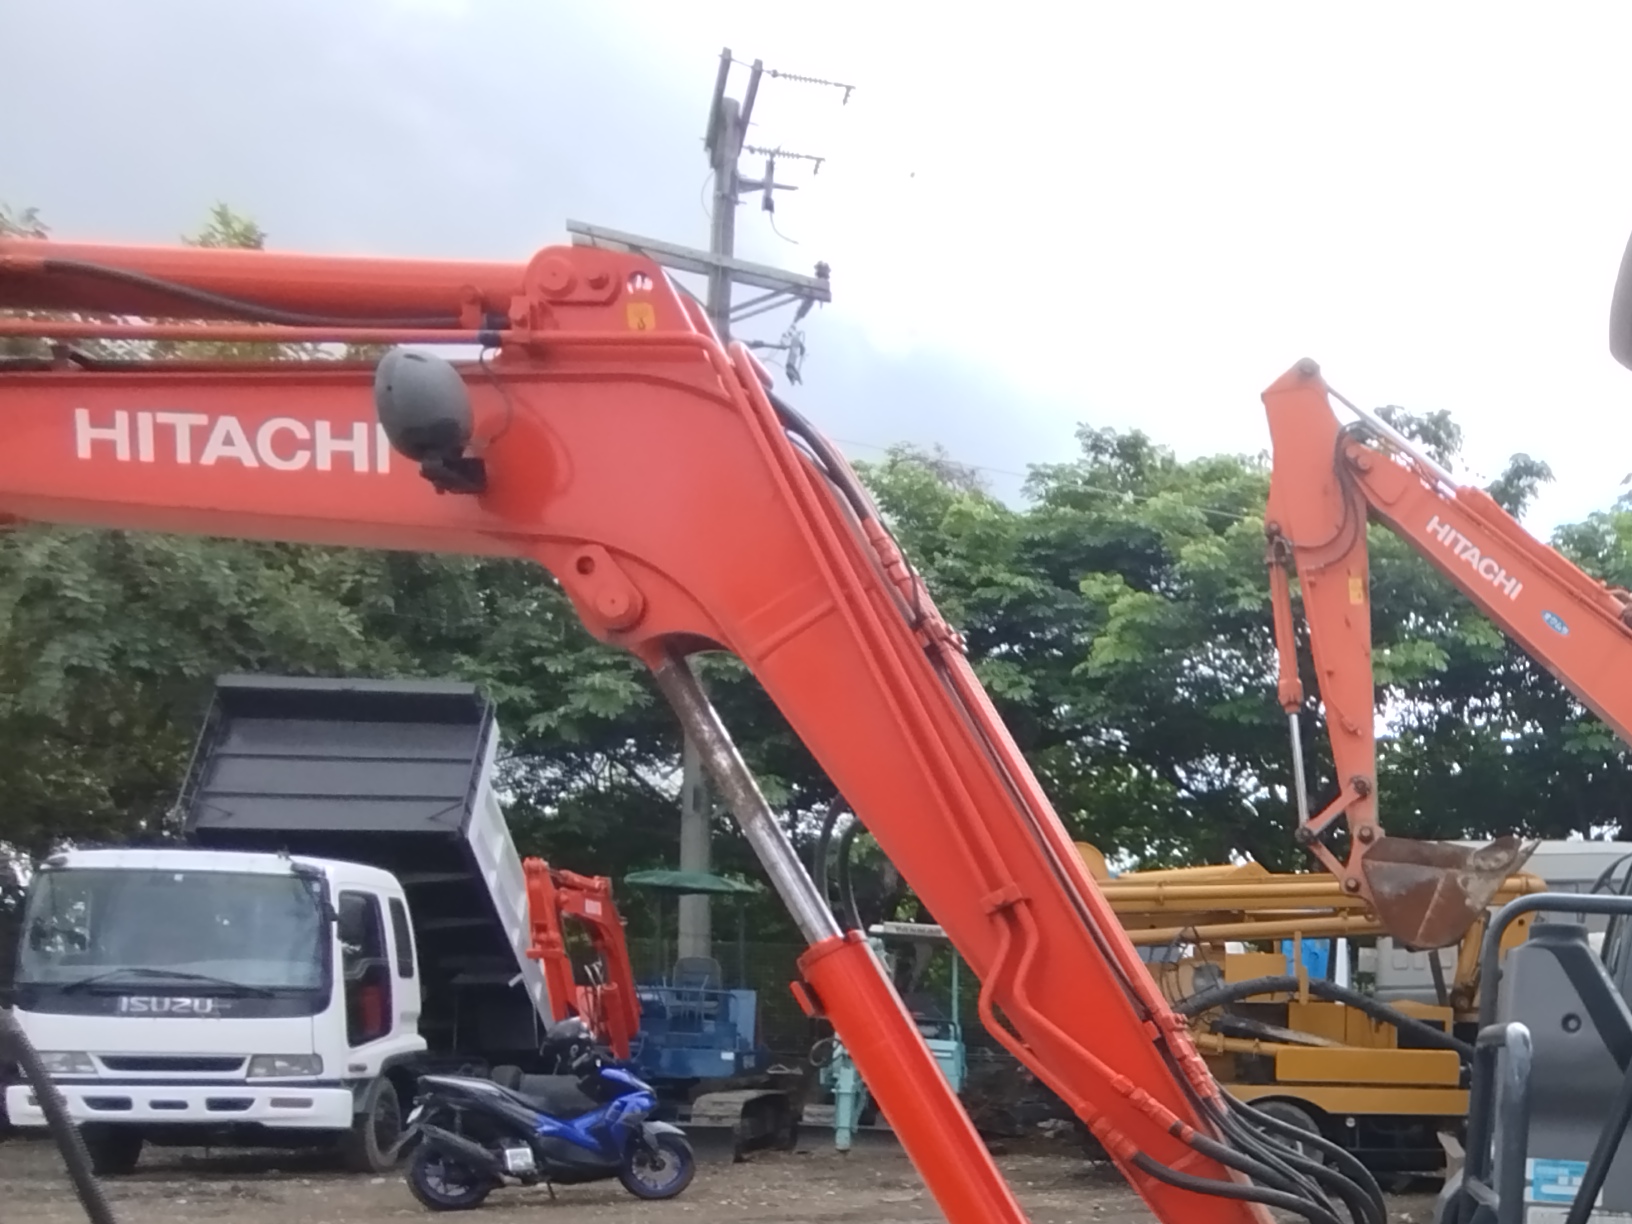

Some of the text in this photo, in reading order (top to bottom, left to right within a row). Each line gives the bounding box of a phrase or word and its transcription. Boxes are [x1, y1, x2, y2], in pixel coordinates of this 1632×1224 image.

[75, 408, 390, 474] HITACHI
[1426, 515, 1523, 601] HITACHI
[121, 996, 212, 1013] ISUZU
